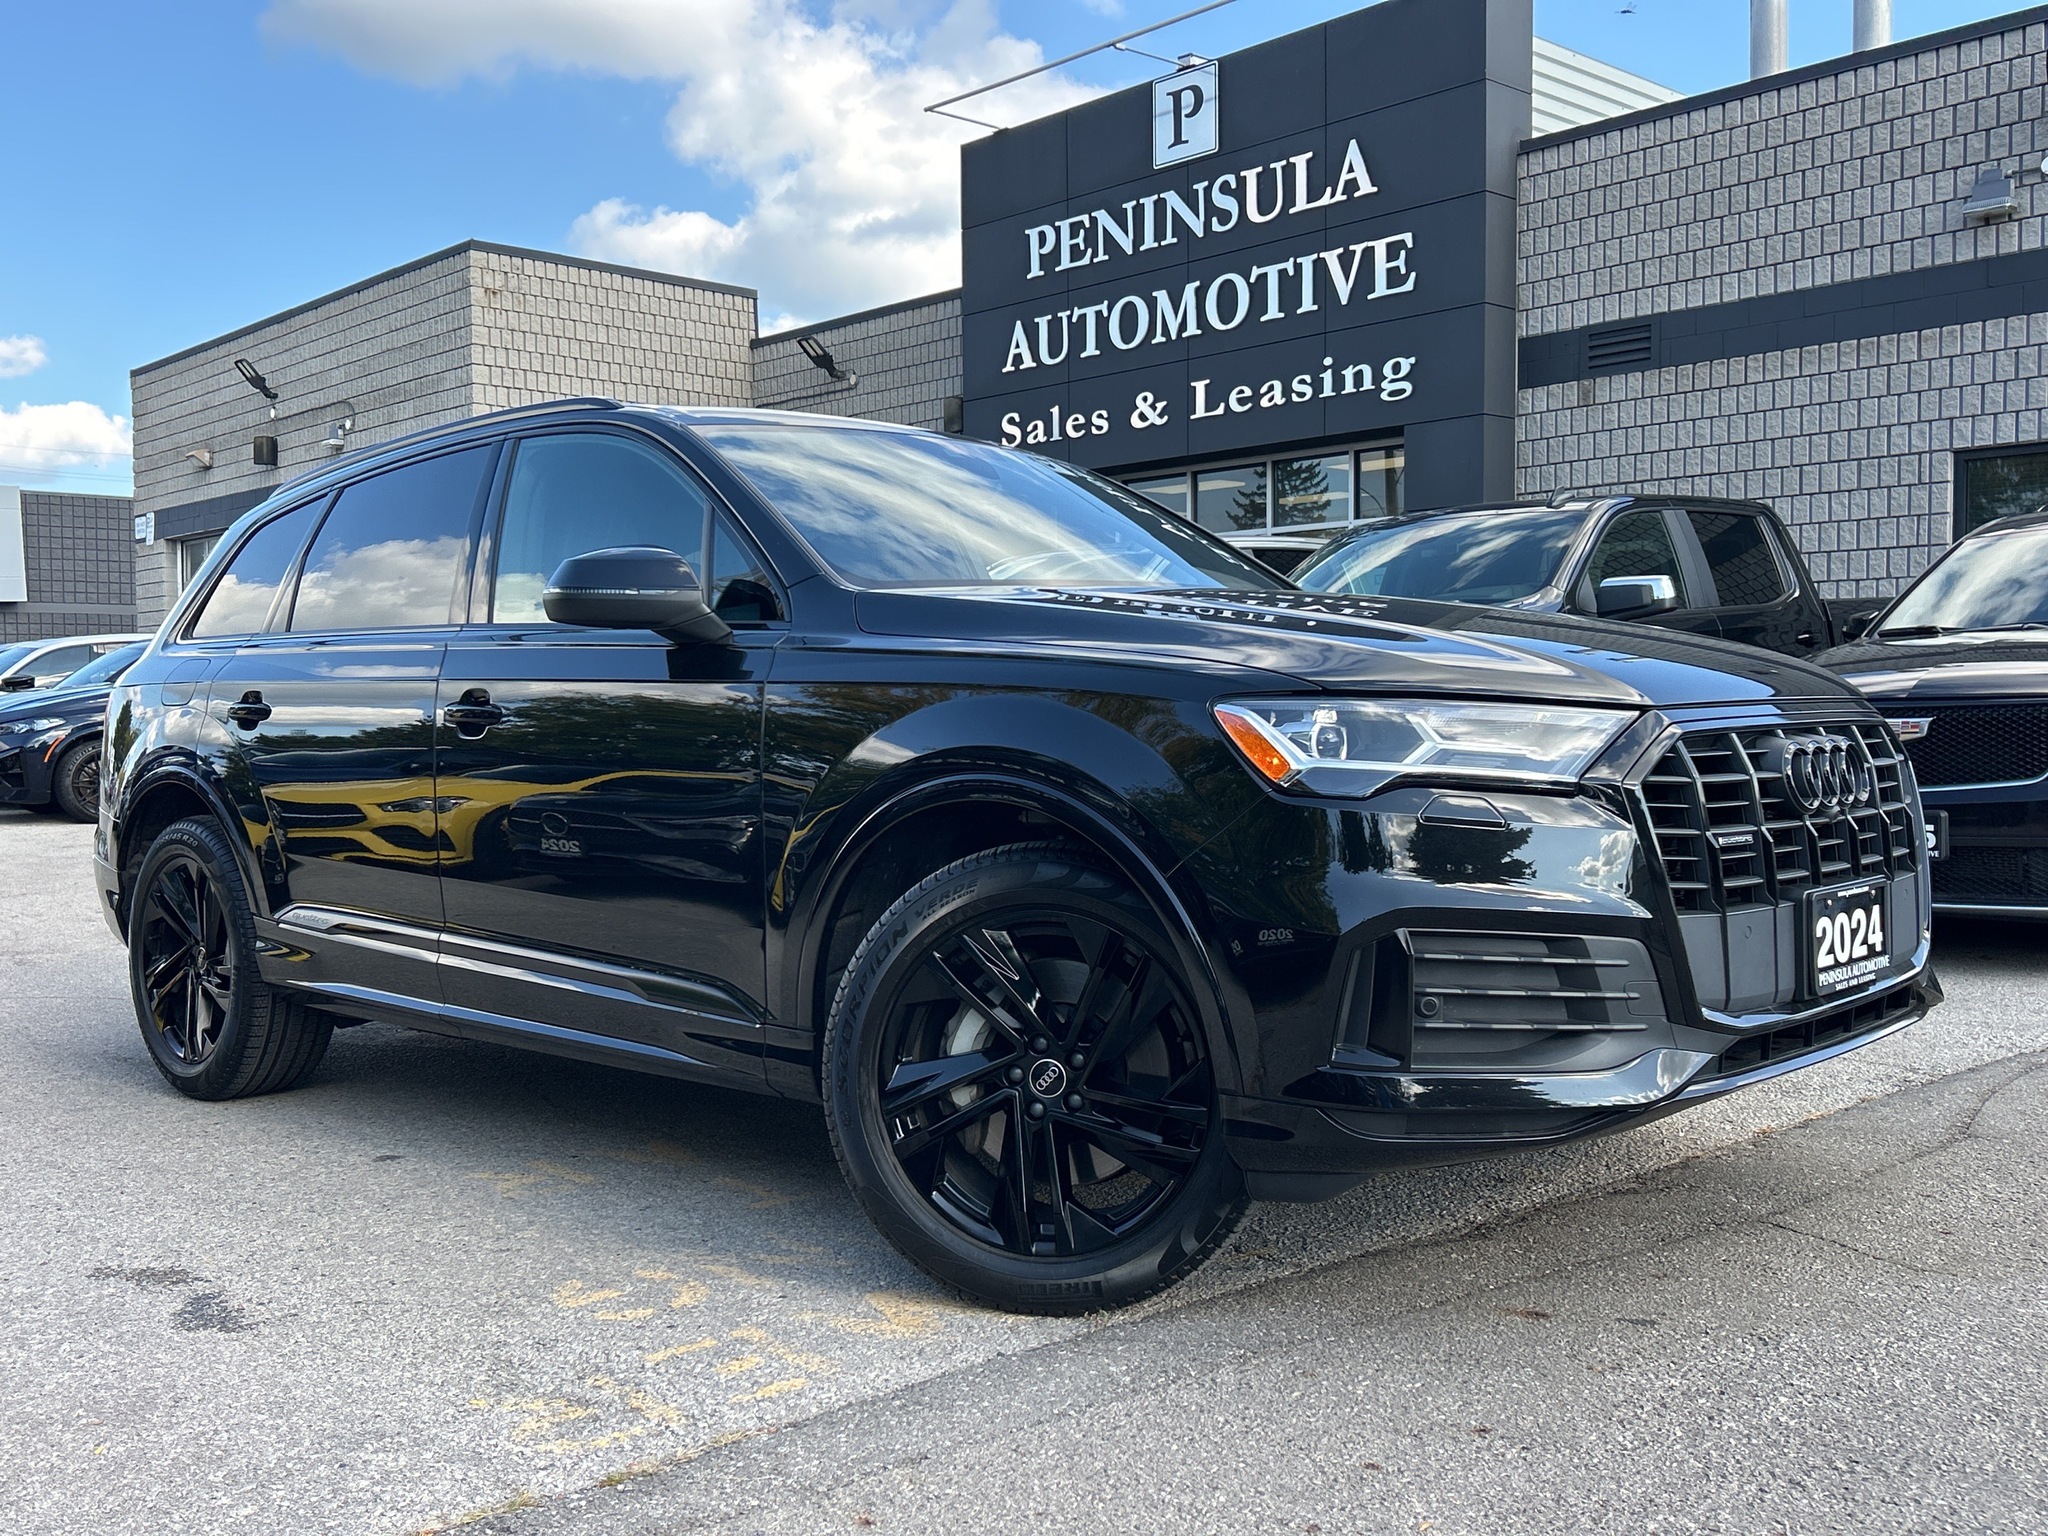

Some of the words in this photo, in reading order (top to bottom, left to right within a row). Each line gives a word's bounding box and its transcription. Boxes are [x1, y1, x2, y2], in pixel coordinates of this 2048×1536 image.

[1166, 82, 1204, 150] P
[1024, 138, 1378, 280] PENINSULA
[1001, 231, 1417, 374] AUTOMOTIVE
[1001, 405, 1109, 448] Sales
[1130, 391, 1169, 430] &
[1190, 356, 1416, 420] Leasing
[914, 878, 979, 918] VERDE
[922, 907, 937, 921] ALL
[939, 888, 976, 910] SEASON
[1815, 904, 1883, 968] 2024
[1818, 963, 1852, 987] PENINSULA
[1852, 955, 1890, 975] AUTOMOTIVE
[837, 920, 910, 1096] SCORPION
